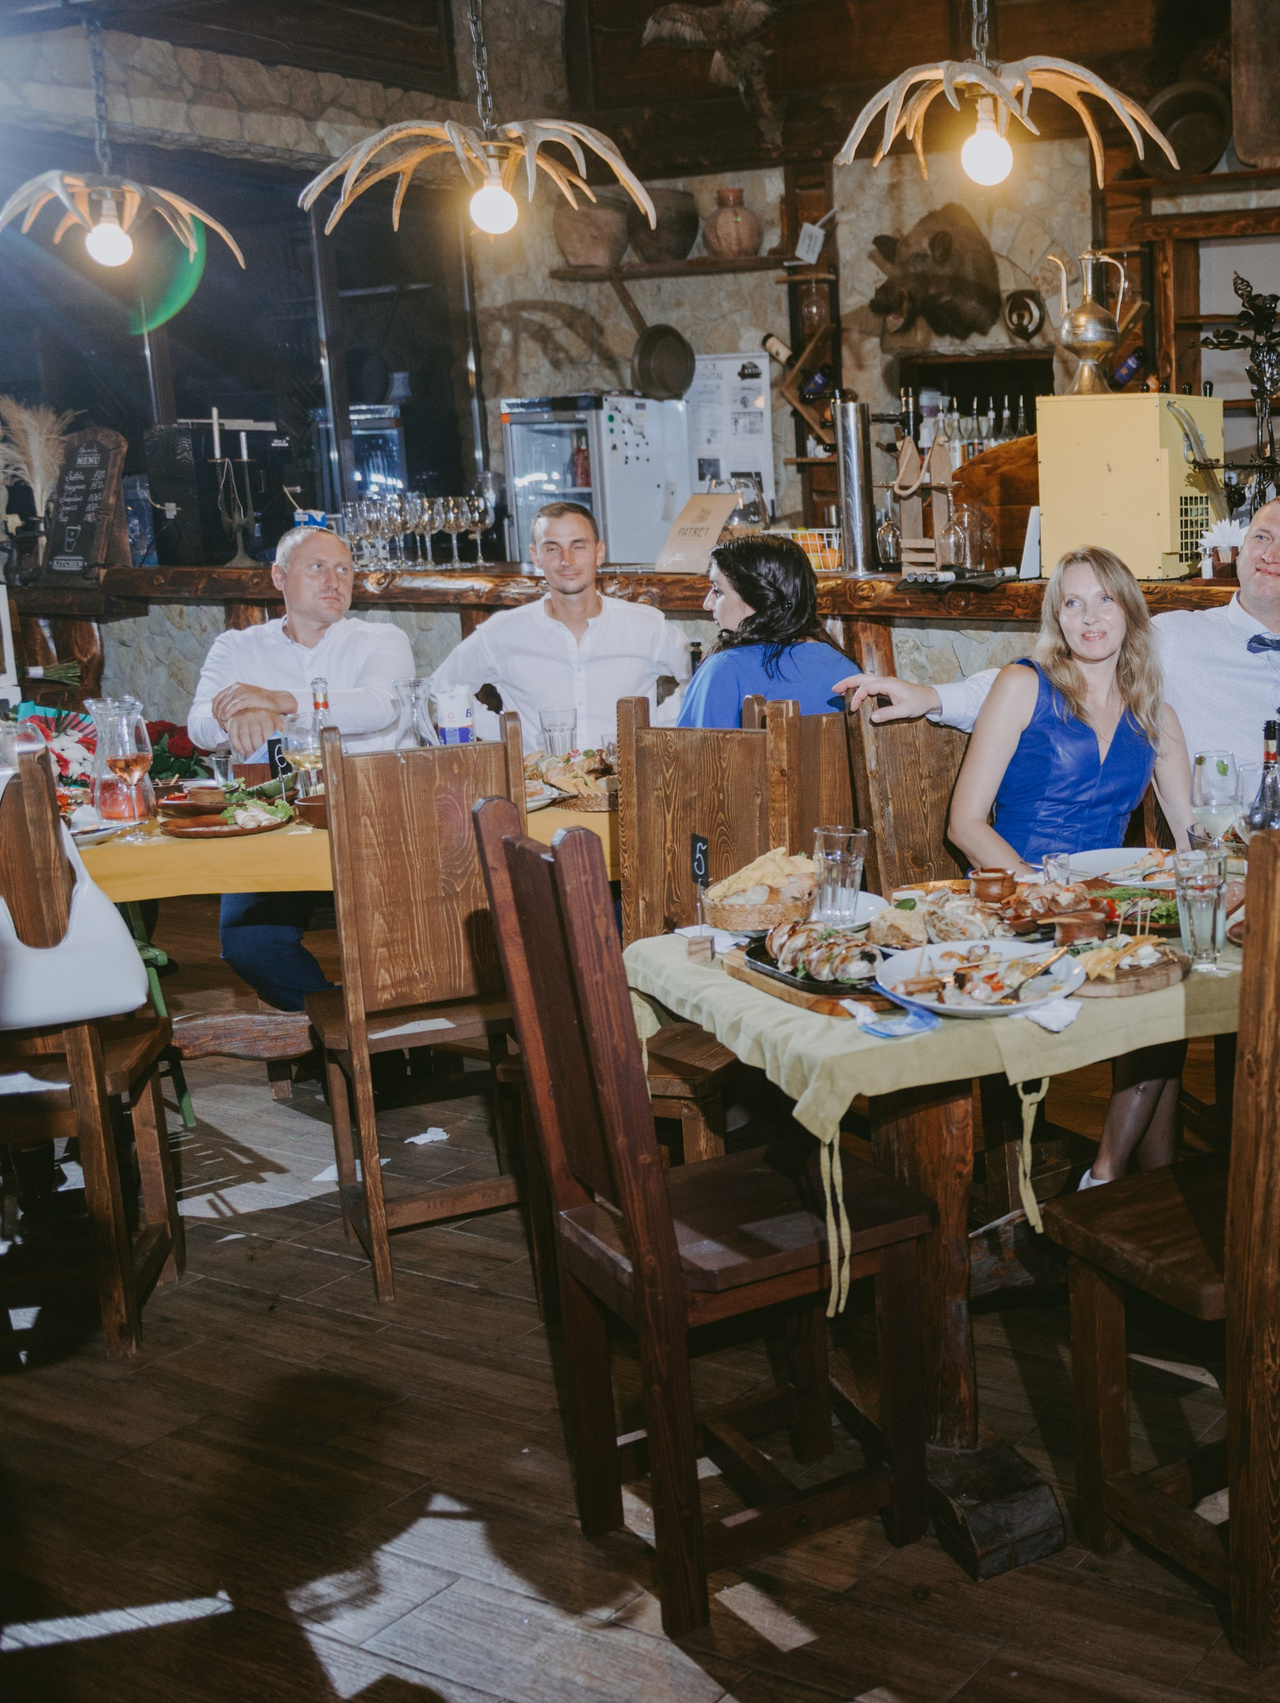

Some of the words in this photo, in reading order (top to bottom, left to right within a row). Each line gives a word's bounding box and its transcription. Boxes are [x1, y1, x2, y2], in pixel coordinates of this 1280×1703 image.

[76, 456, 101, 465] MENU
[52, 560, 84, 568] KITCHEN
[274, 743, 288, 768] 6
[693, 842, 708, 875] 5
